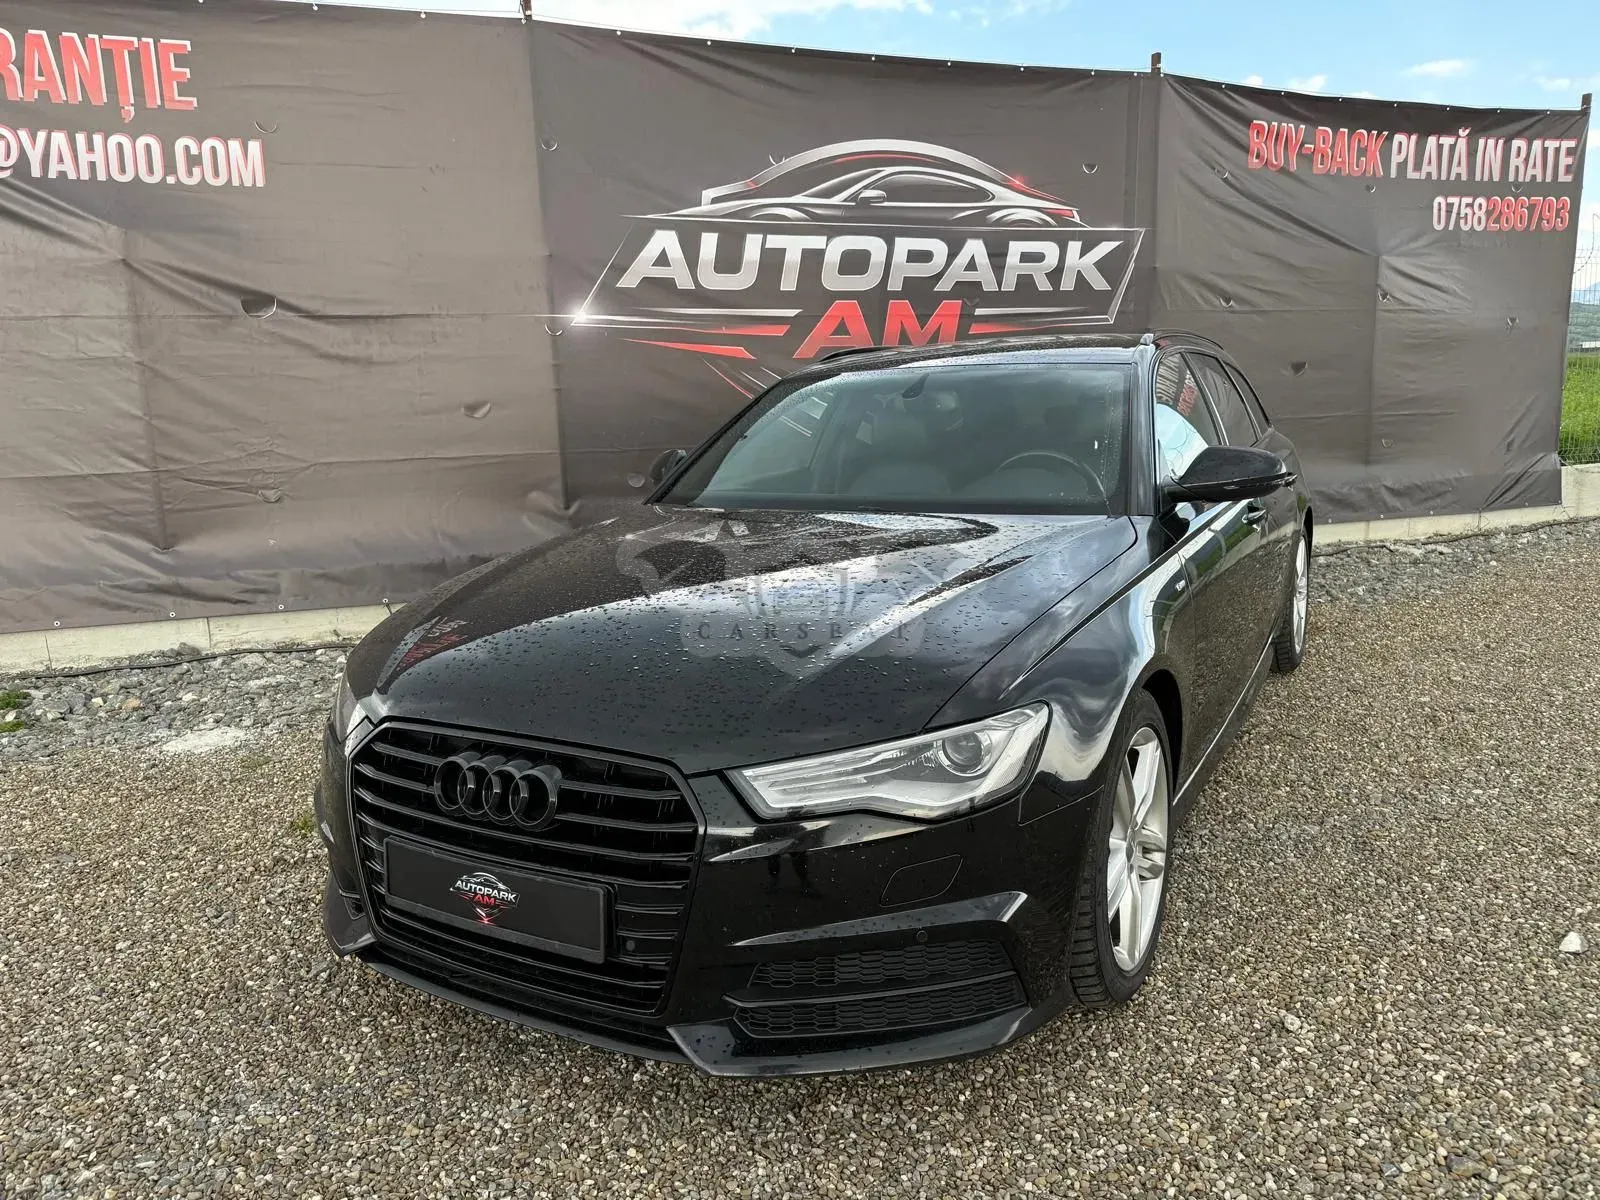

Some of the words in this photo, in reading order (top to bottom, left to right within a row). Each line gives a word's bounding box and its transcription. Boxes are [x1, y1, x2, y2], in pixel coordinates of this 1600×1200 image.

[1248, 120, 1389, 178] BUY-BACK
[1390, 127, 1471, 181] PLATĂ
[1475, 137, 1504, 182] IN
[1508, 137, 1578, 183] RATE
[1432, 195, 1571, 232] 0758286793
[616, 229, 1124, 292] AUTOPARK
[792, 300, 962, 359] AM
[455, 880, 517, 902] AUTOPARK
[474, 894, 495, 906] AM
